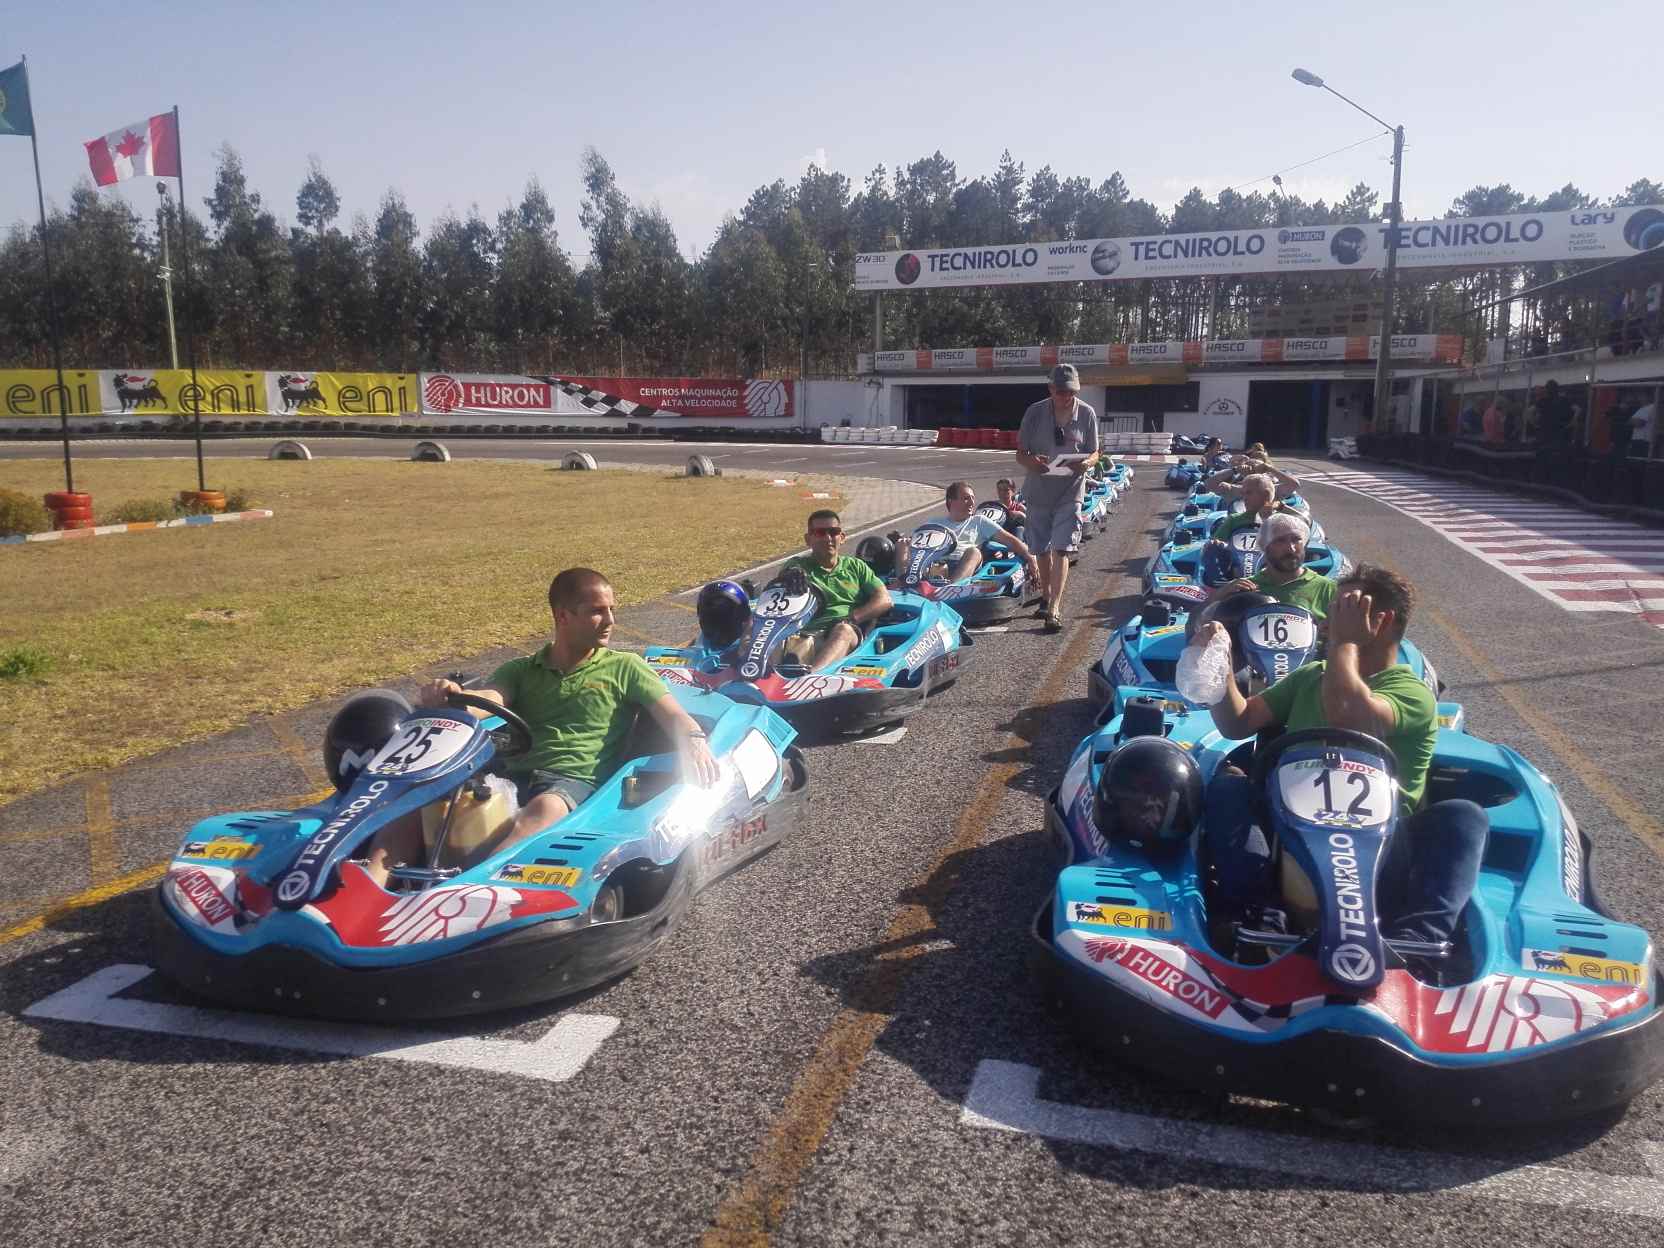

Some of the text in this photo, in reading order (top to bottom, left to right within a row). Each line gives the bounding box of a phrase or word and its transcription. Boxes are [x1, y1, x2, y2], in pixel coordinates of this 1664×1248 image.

[1379, 219, 1544, 249] TECNIROLO
[1130, 234, 1265, 261] TECNIROLO
[928, 248, 1038, 272] TECNIROLO
[995, 349, 1027, 359] HASCO
[1060, 347, 1095, 357] HASCO
[1131, 345, 1167, 354] HASCO
[1206, 342, 1245, 352] HASCO
[1286, 340, 1328, 350] HASCO
[1373, 338, 1416, 349] HSCO
[934, 351, 964, 360] HASCO
[6, 373, 89, 414] eni
[178, 373, 256, 413] eni
[337, 373, 408, 413] eni
[471, 385, 545, 406] HURON
[639, 388, 679, 397] CENTROS
[661, 399, 737, 408] ALTA VELOCIDADE
[913, 533, 932, 545] 21
[1240, 535, 1256, 550] 17
[766, 591, 790, 612] 35
[1258, 616, 1289, 643] 16
[382, 727, 444, 765] 25
[1313, 769, 1373, 817] 12
[294, 780, 389, 869] TECNIROLO
[527, 867, 576, 886] eni
[1328, 833, 1367, 941] TECNIROLO
[183, 873, 231, 919] HURON
[1113, 910, 1167, 930] eni
[1129, 952, 1221, 1012] HURON
[1579, 961, 1642, 985] eni
